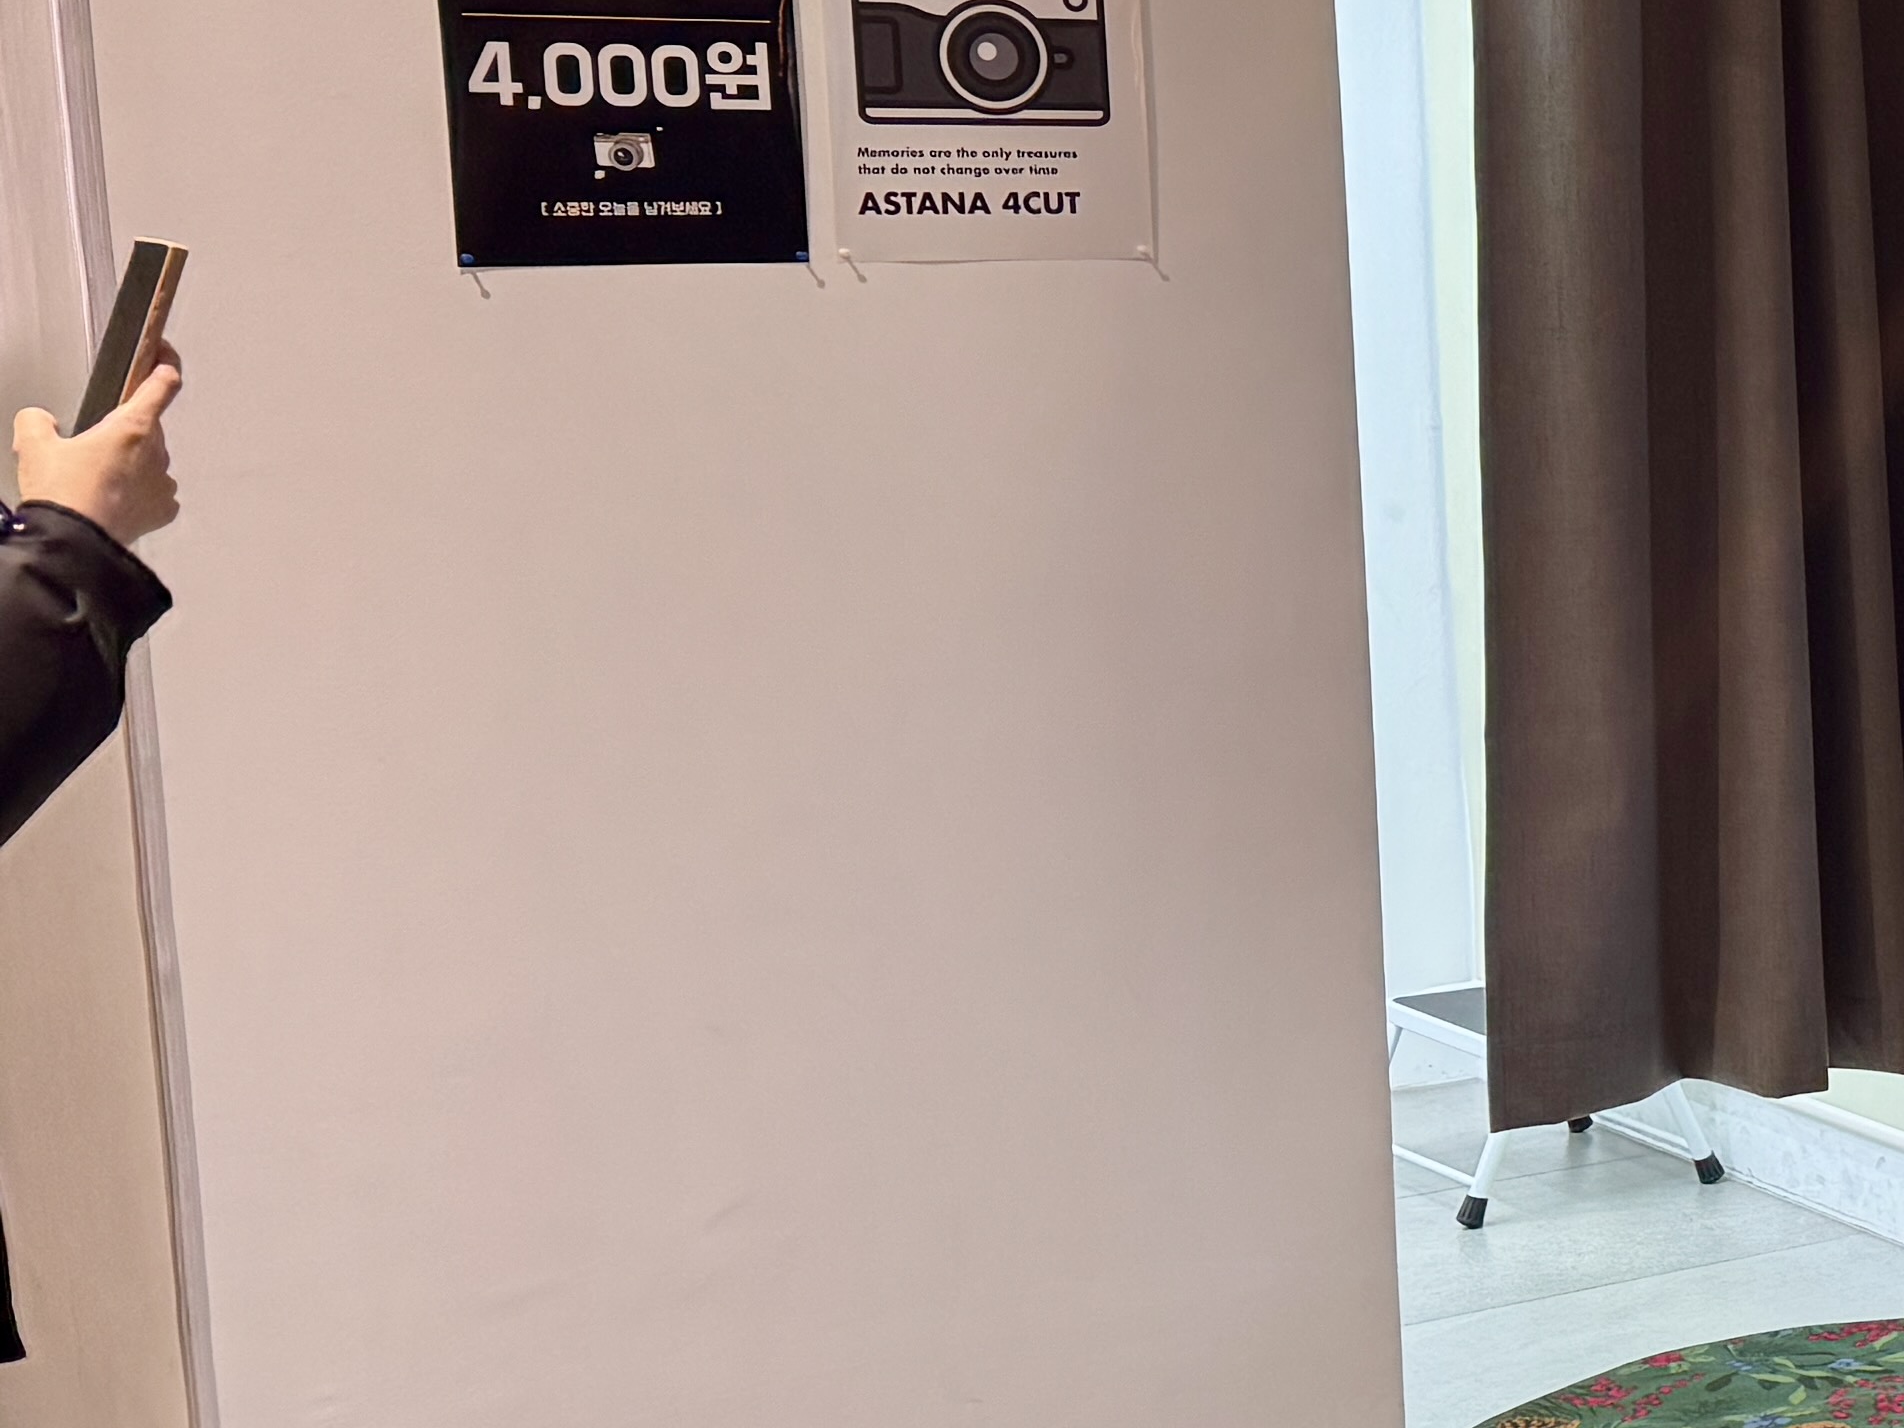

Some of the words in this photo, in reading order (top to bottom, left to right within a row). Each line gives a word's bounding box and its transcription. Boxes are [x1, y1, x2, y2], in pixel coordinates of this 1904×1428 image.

[857, 146, 925, 159] Memories
[929, 149, 952, 159] are
[956, 147, 978, 159] the
[982, 147, 1012, 161] only
[1016, 148, 1078, 160] treasures
[858, 164, 886, 175] that
[890, 164, 908, 175] do
[913, 165, 936, 175] not
[940, 164, 990, 178] change
[994, 166, 1025, 176] over
[1029, 164, 1059, 176] time
[553, 201, 595, 216] 소중한
[599, 201, 640, 216] 오늘을
[643, 201, 713, 216] 남겨보세요
[858, 191, 992, 216] ASTANA
[1001, 191, 1081, 215] 4CUT
